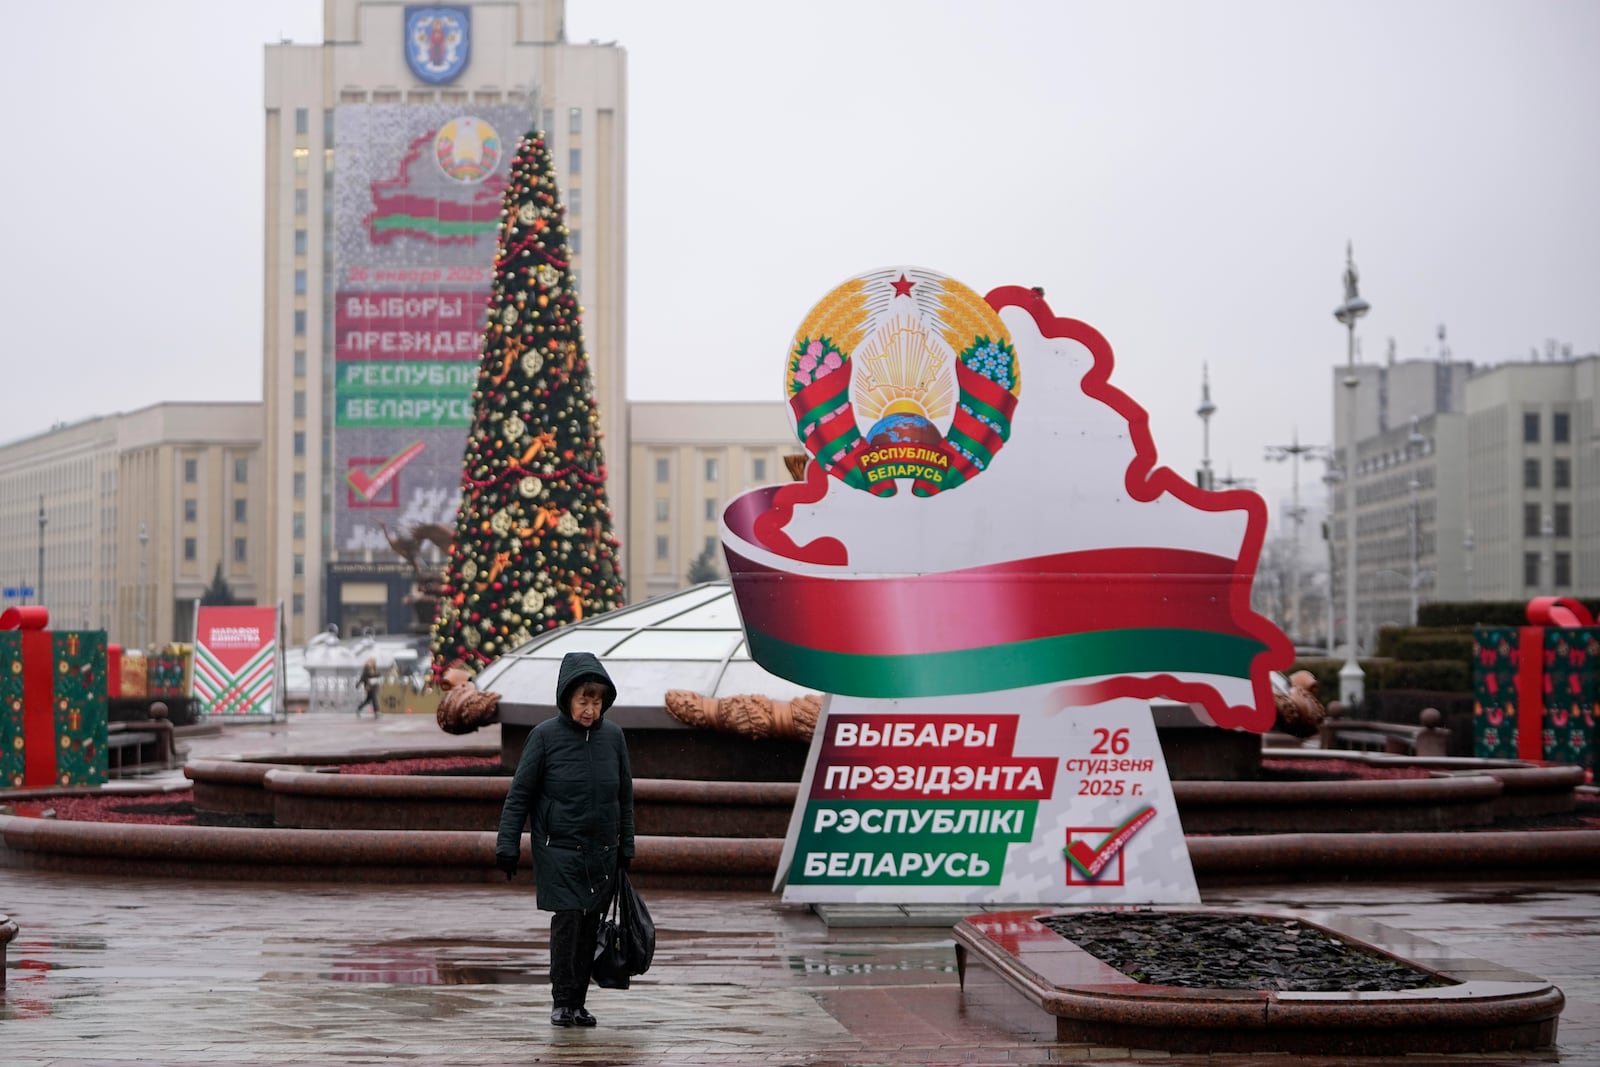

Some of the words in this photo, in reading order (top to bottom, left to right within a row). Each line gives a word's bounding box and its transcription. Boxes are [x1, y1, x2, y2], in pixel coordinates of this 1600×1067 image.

[349, 265, 369, 282] 26
[374, 268, 441, 285] января
[446, 265, 485, 283] 2025
[346, 297, 462, 318] ВЫБОРЫ
[346, 399, 474, 419] БЕЛАРУСЬ
[861, 447, 947, 467] РЭСПУБЛІКА
[867, 464, 942, 482] БЕЛАРУСЬ
[834, 723, 998, 747] ВЫБАРЫ
[1090, 727, 1130, 755] 26
[1065, 759, 1154, 775] студзеня
[824, 765, 1043, 794] ПРЭЗІДЭНТА
[1077, 779, 1126, 796] 2025
[1131, 783, 1143, 796] г.
[813, 808, 1025, 834] РЭСПУБЛІКІ
[803, 852, 990, 877] БЕЛАРУСЬ
